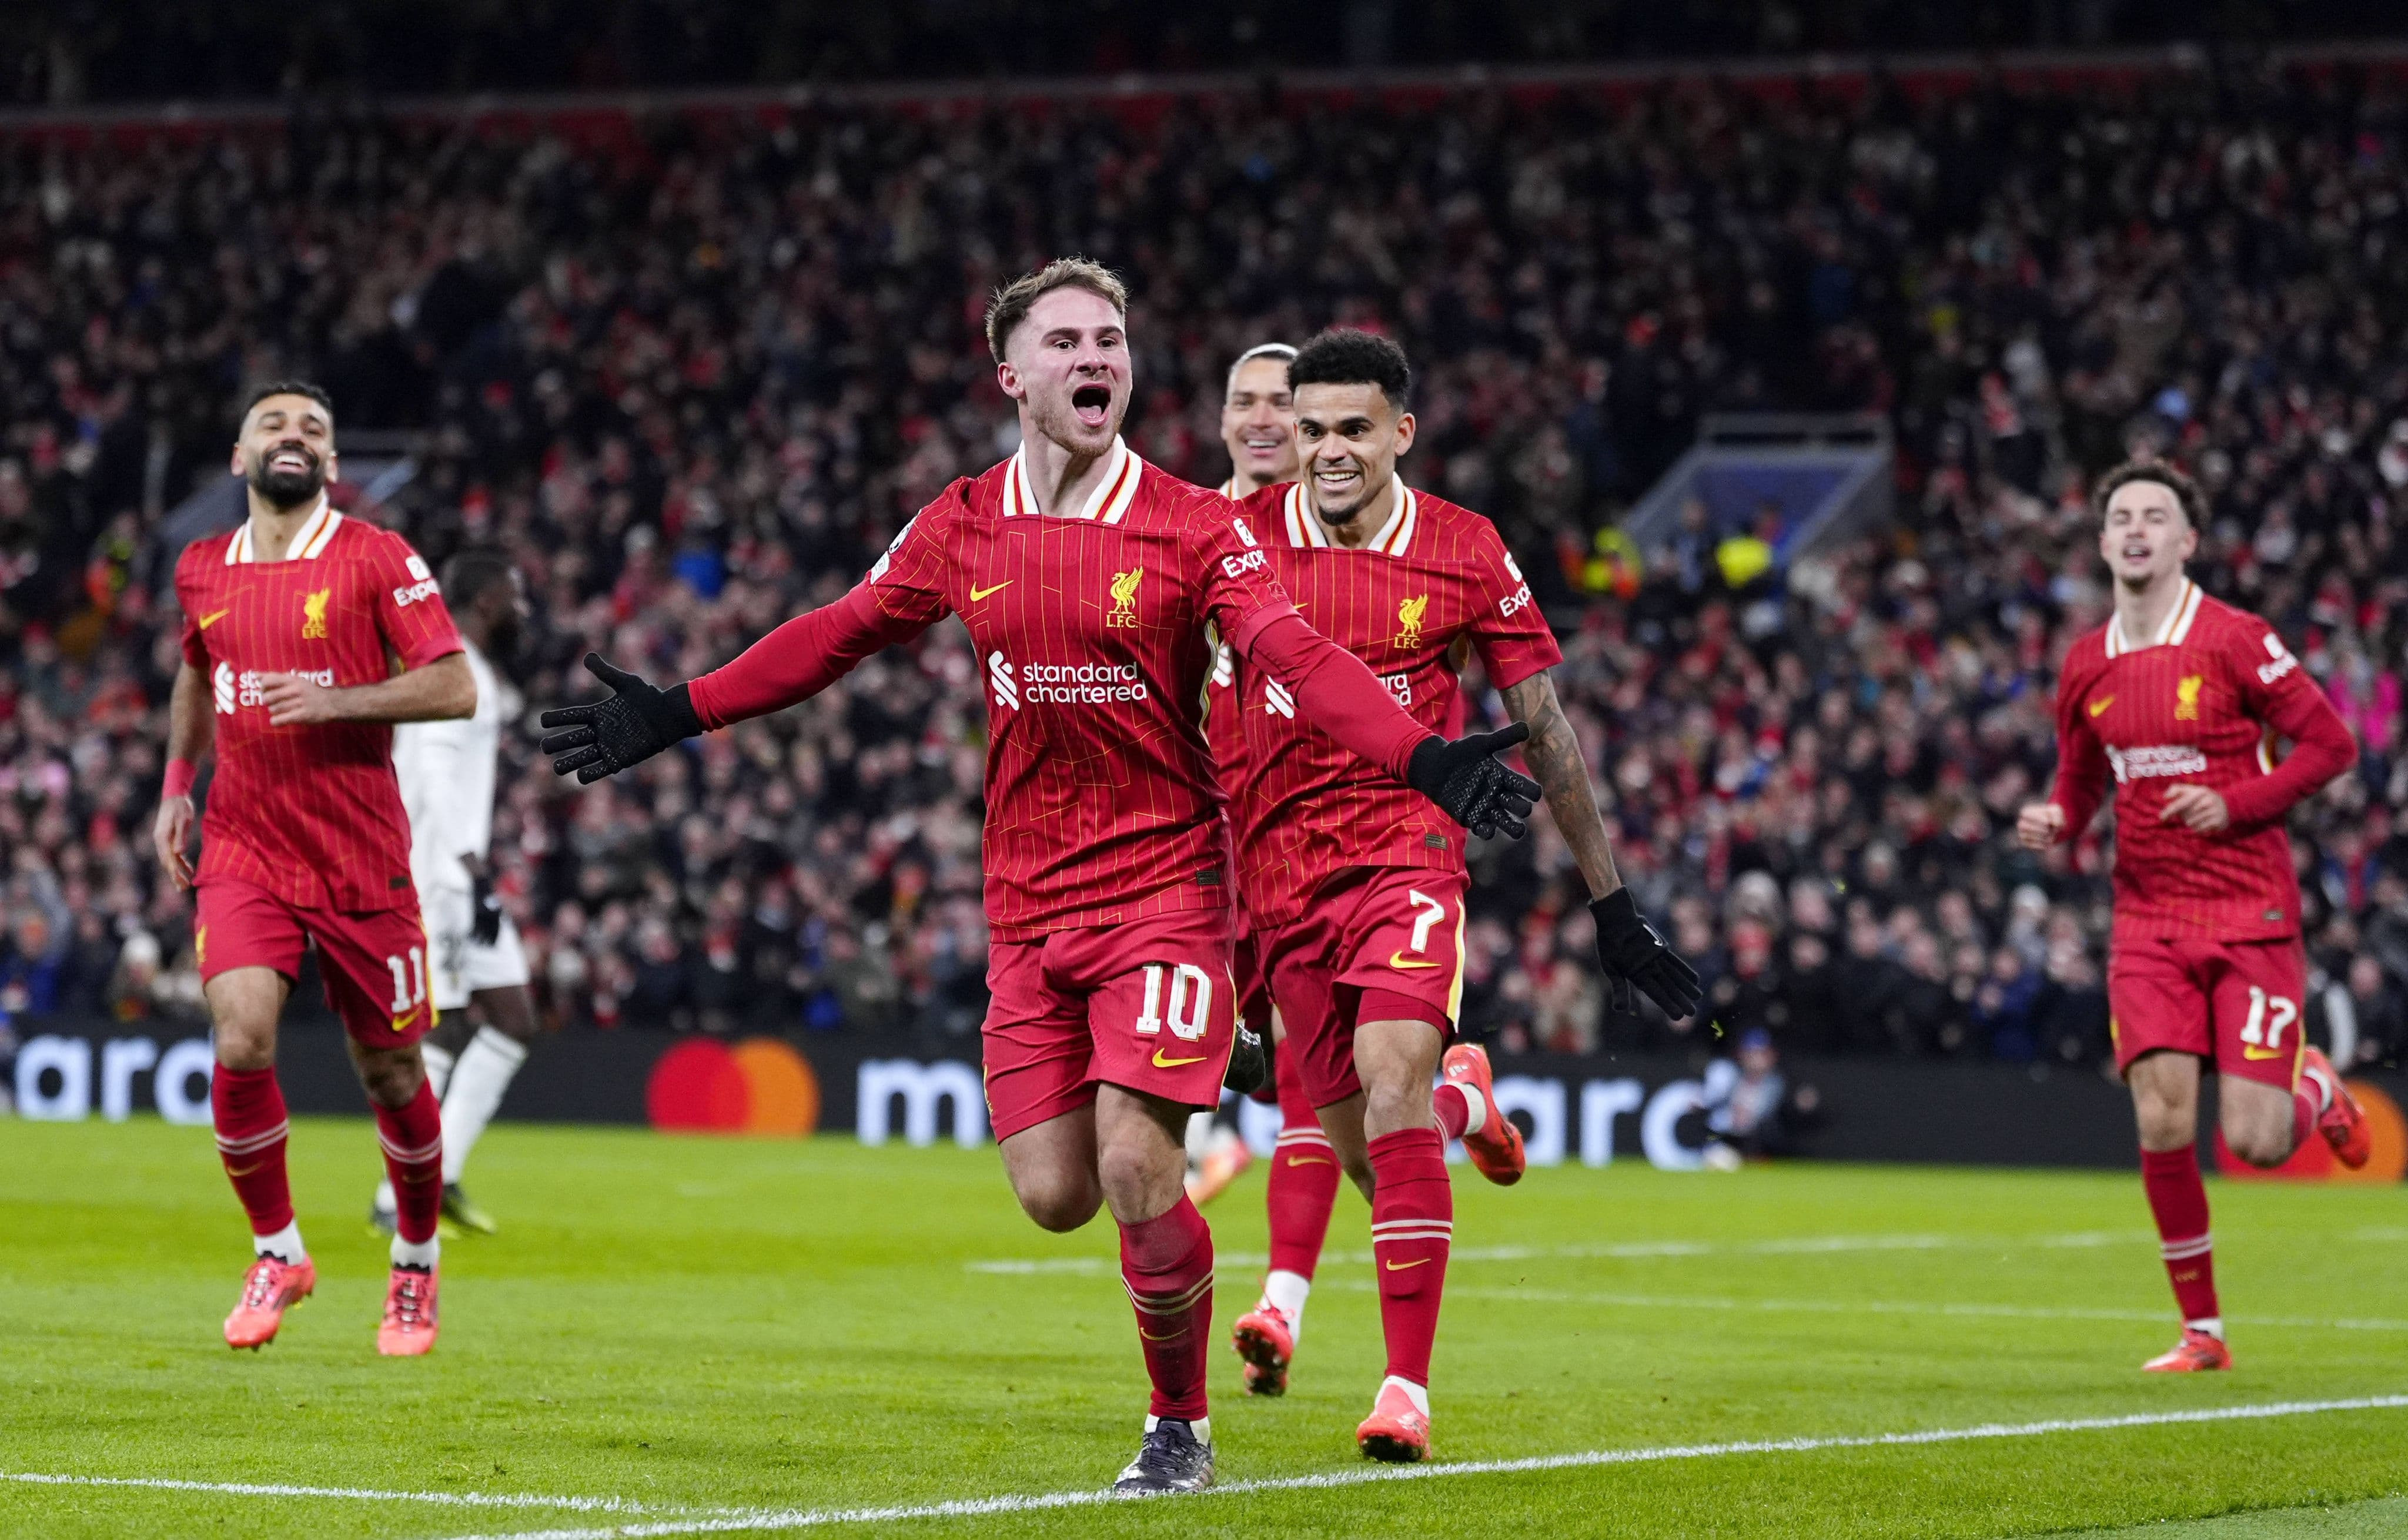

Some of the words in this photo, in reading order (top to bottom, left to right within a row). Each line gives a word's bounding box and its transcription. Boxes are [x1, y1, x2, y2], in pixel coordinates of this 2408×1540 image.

[1023, 661, 1137, 682] standard
[1025, 679, 1148, 704] chartered
[1409, 889, 1445, 953] 7
[387, 946, 426, 1013] 11
[1136, 962, 1212, 1042] 10
[2240, 985, 2297, 1049] 17
